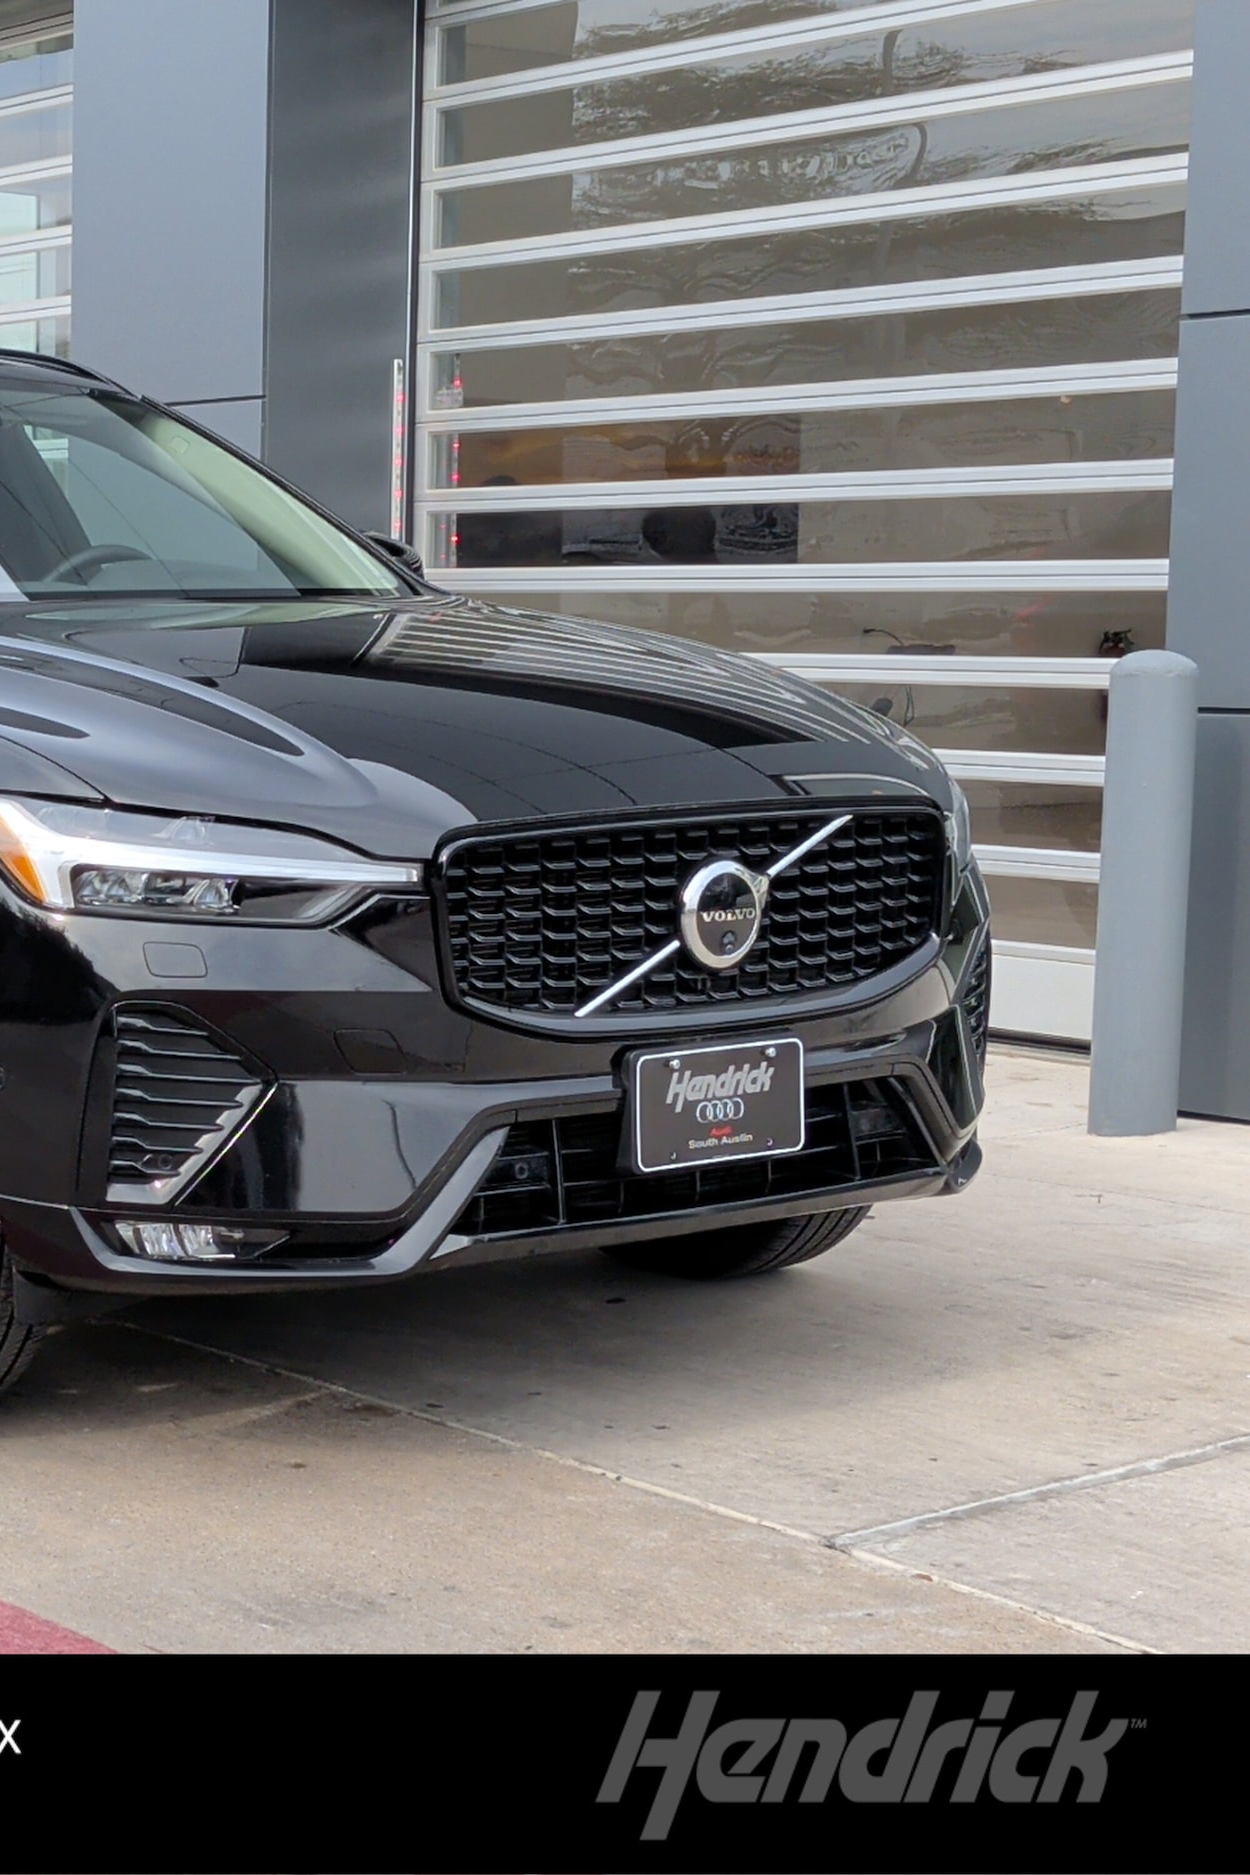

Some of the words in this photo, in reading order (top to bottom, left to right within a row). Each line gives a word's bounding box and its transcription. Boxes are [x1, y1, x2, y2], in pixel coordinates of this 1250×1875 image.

[701, 907, 756, 923] VOLVO
[665, 1061, 775, 1113] Hendrick
[688, 1138, 719, 1150] South
[720, 1132, 754, 1146] Austin
